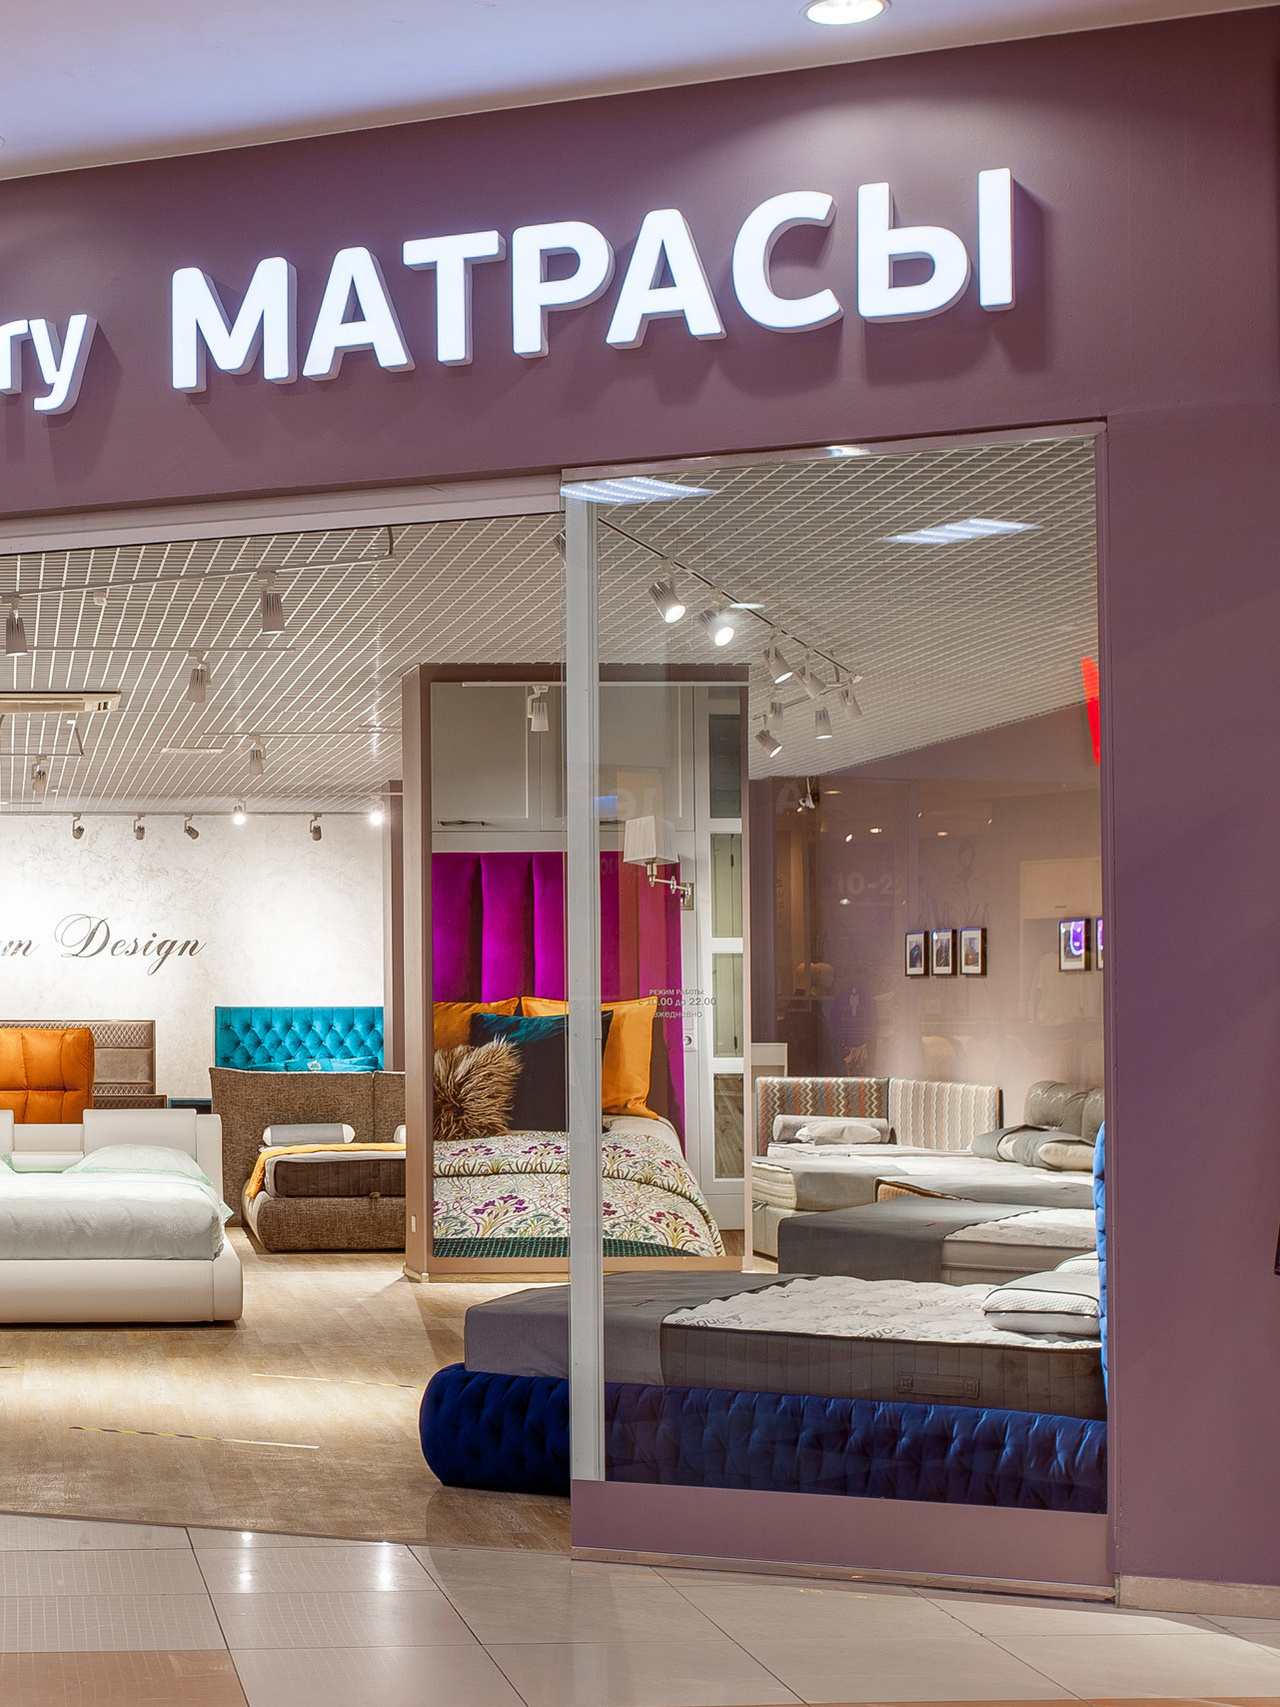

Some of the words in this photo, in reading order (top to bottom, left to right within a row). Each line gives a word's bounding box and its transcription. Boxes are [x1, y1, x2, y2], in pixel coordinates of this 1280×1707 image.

[170, 167, 1015, 393] МАТРАСЫ
[55, 913, 207, 976] Design
[646, 997, 673, 1007] 10.00
[675, 999, 687, 1007] до
[689, 997, 717, 1007] 22.00
[649, 988, 675, 996] РЕЖИМ
